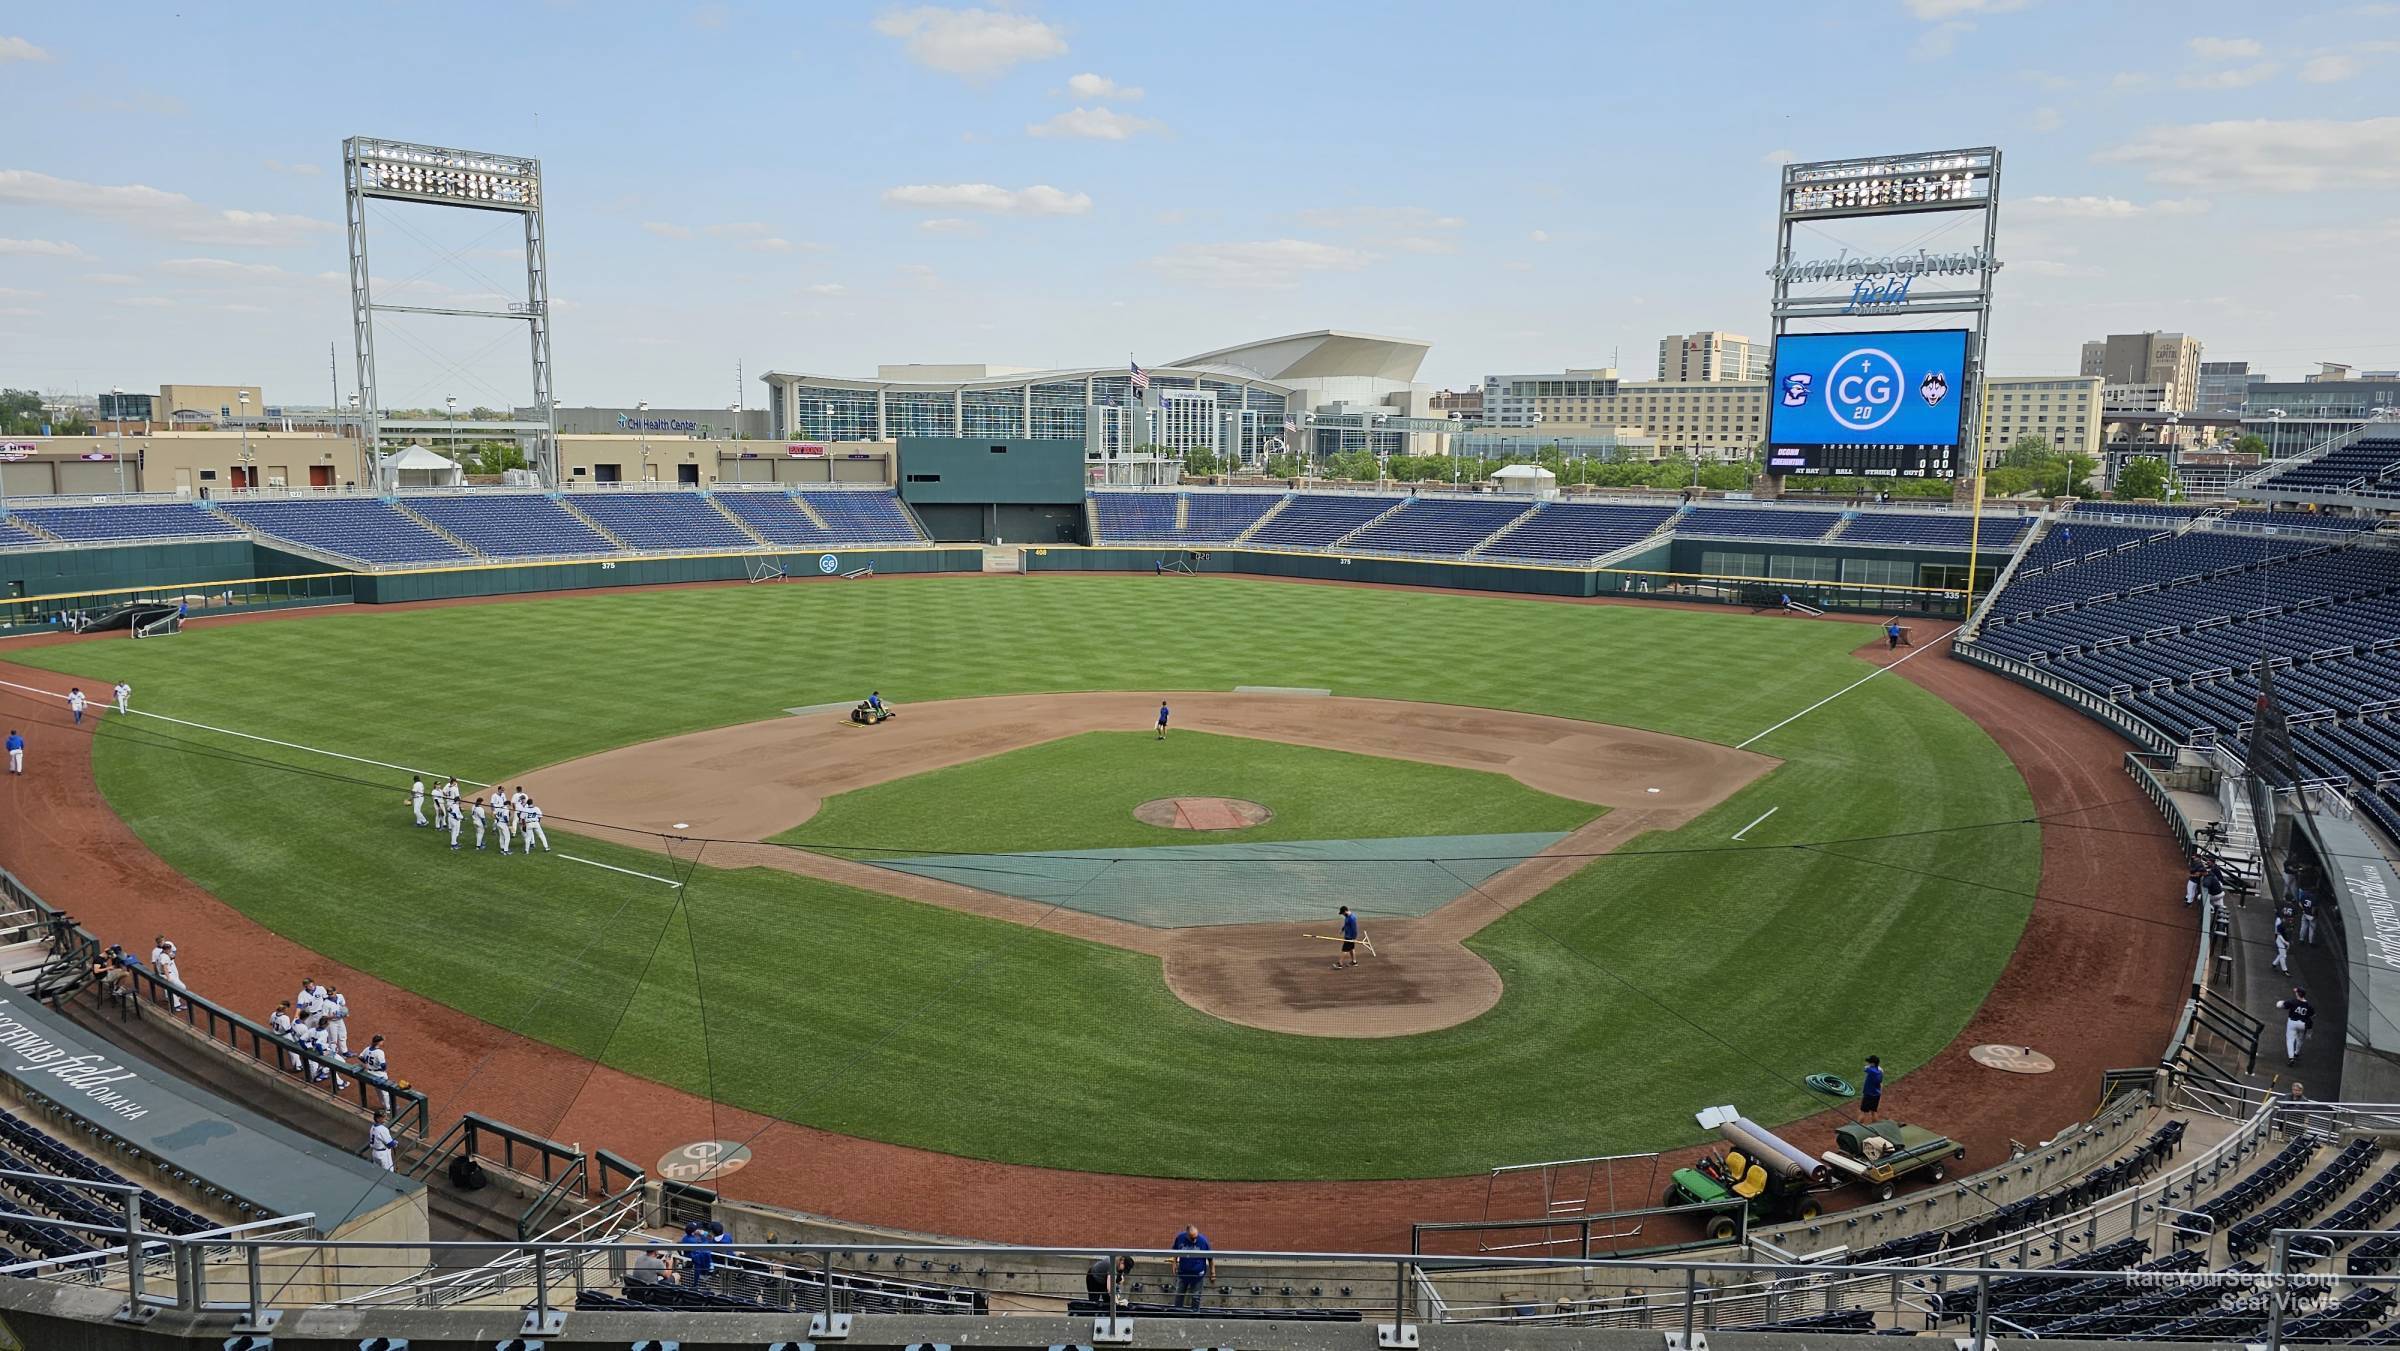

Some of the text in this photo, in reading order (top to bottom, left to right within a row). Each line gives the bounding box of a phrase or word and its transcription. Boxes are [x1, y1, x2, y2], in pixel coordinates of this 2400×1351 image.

[1840, 275, 1912, 313] field
[1854, 304, 1902, 315] OMAHA
[1839, 375, 1891, 405] CG
[1853, 406, 1873, 419] 20
[628, 418, 697, 431] CHI Health Center
[601, 562, 616, 570] 375
[823, 560, 835, 568] CG
[1943, 591, 1960, 600] 335
[16, 1055, 138, 1090] field
[86, 1086, 149, 1121] OMAHA
[664, 1158, 745, 1178] fnbo
